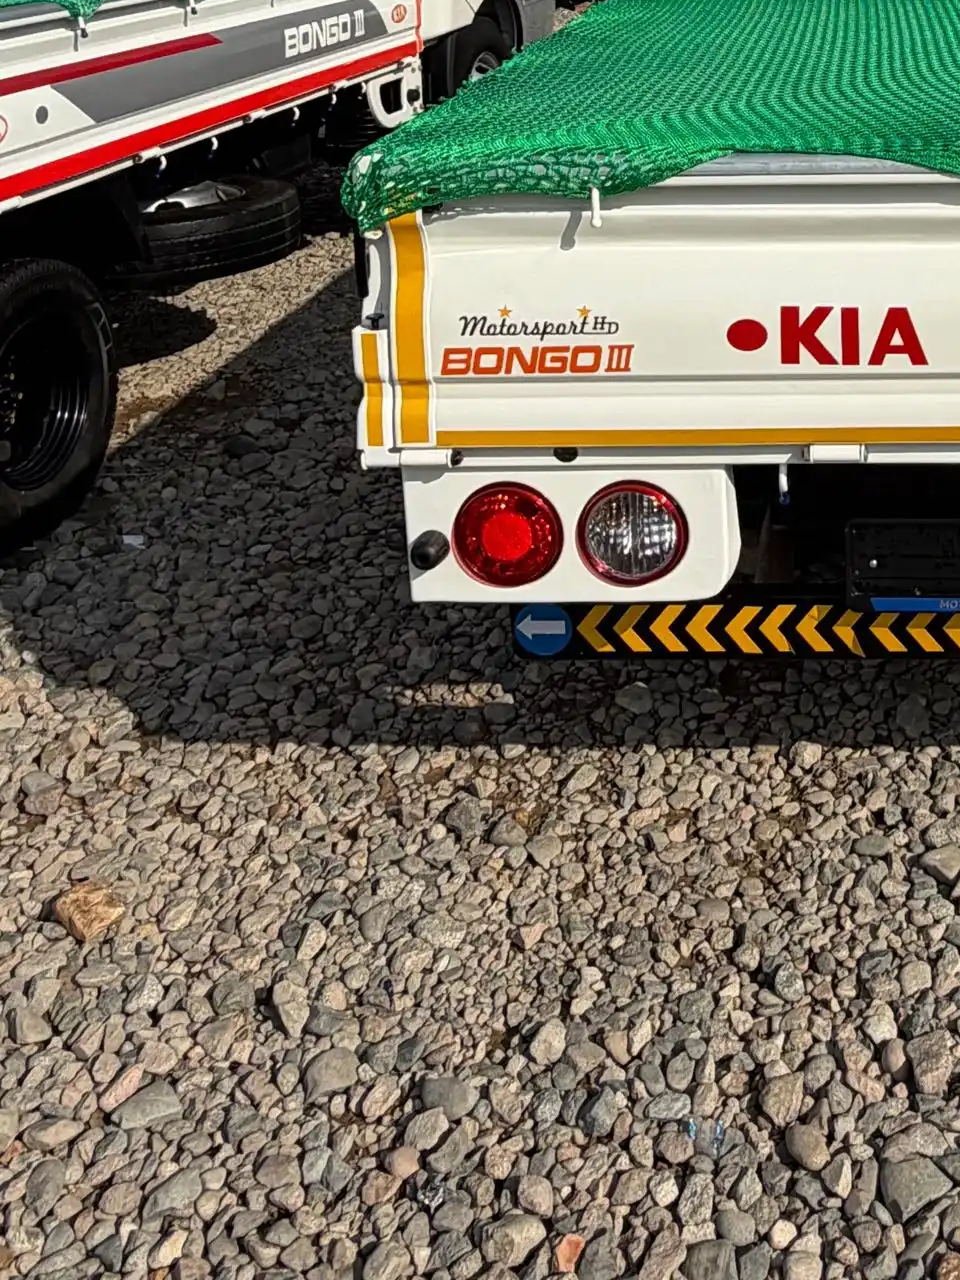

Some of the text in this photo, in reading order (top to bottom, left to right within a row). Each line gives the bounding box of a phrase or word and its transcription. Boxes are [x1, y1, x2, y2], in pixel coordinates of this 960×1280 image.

[283, 13, 351, 58] BONGO
[459, 316, 590, 342] Motorsport
[780, 305, 929, 366] KIA
[440, 344, 635, 376] BONGO III
